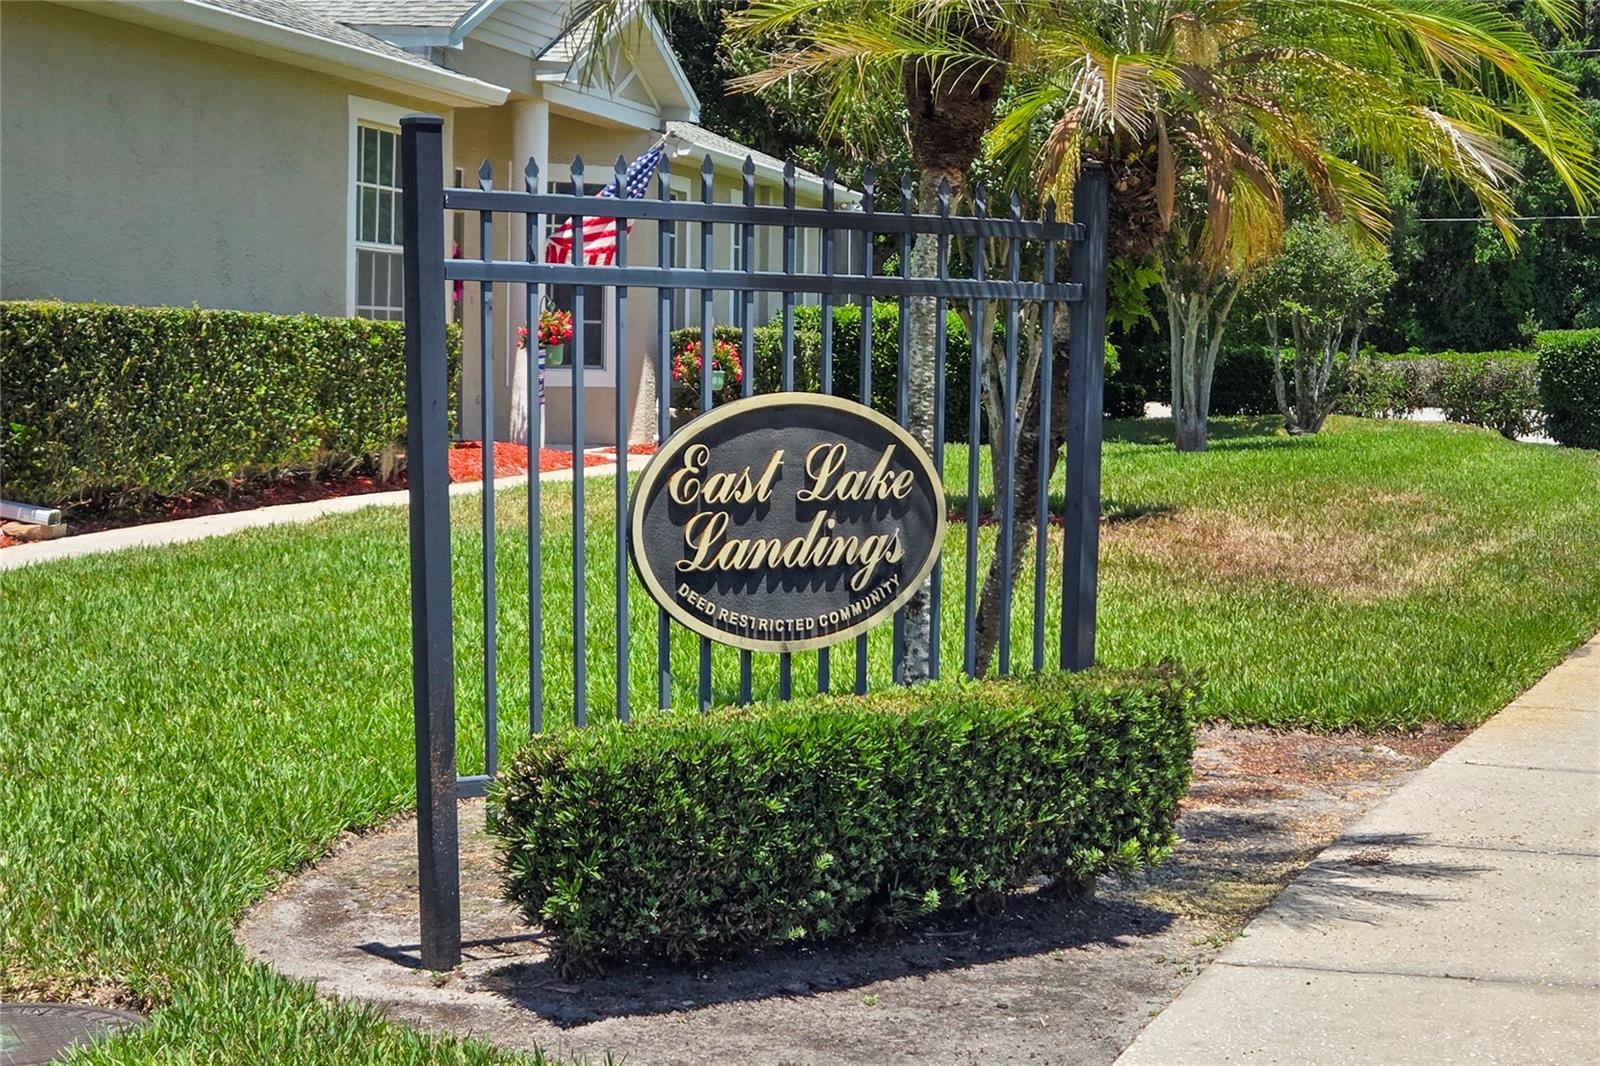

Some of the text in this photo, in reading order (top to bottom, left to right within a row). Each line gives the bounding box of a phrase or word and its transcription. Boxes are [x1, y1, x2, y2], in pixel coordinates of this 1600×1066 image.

[668, 442, 915, 505] East Lake
[674, 509, 905, 591] Landings
[677, 573, 901, 632] DEED RESTRICTED COMMUNITY
